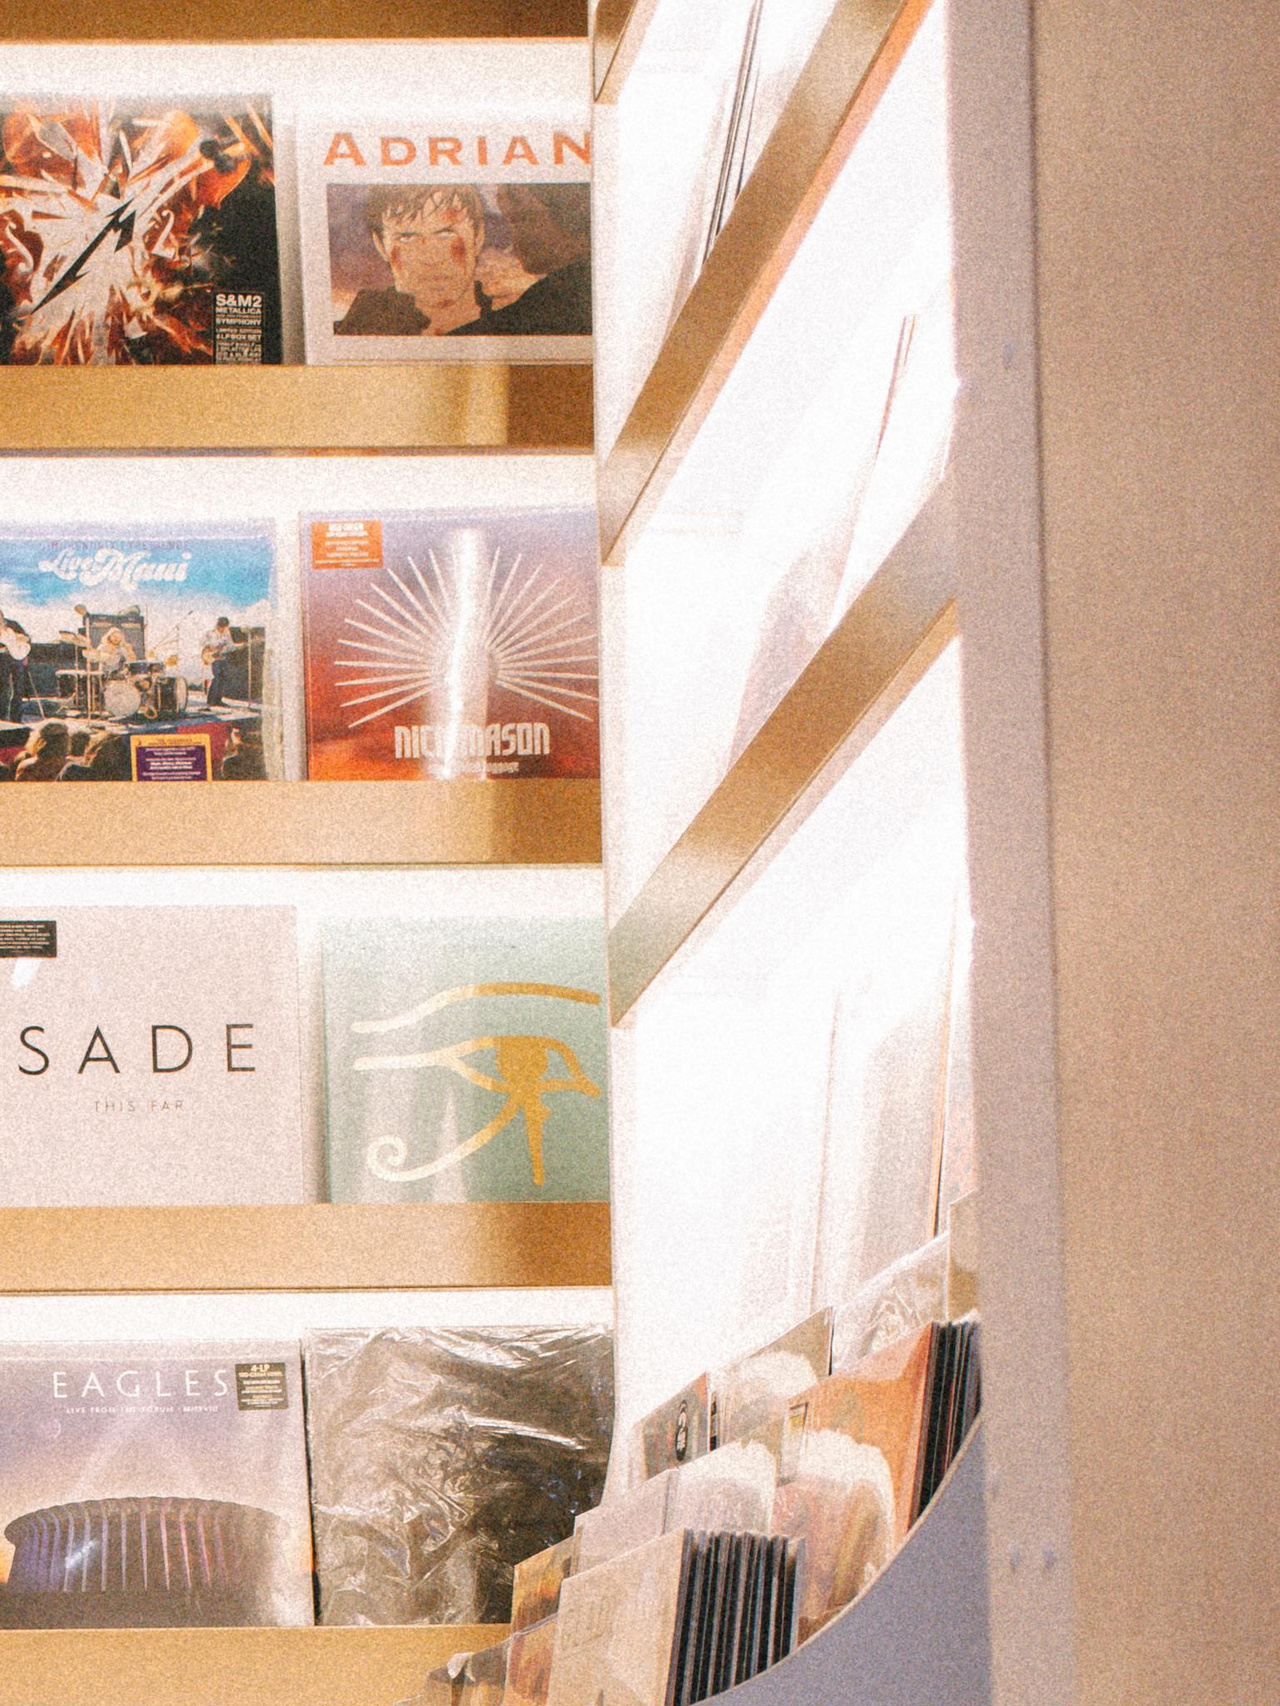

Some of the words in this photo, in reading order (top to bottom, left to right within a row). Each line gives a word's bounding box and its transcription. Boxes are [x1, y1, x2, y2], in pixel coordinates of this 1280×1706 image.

[323, 132, 592, 167] ADRIAN
[216, 293, 262, 308] S&M2
[394, 725, 451, 759] NIC
[461, 722, 551, 757] MASON
[18, 1023, 256, 1076] SADE
[93, 1101, 136, 1113] THIS
[151, 1100, 184, 1112] FAR
[52, 1369, 228, 1399] EAGLES
